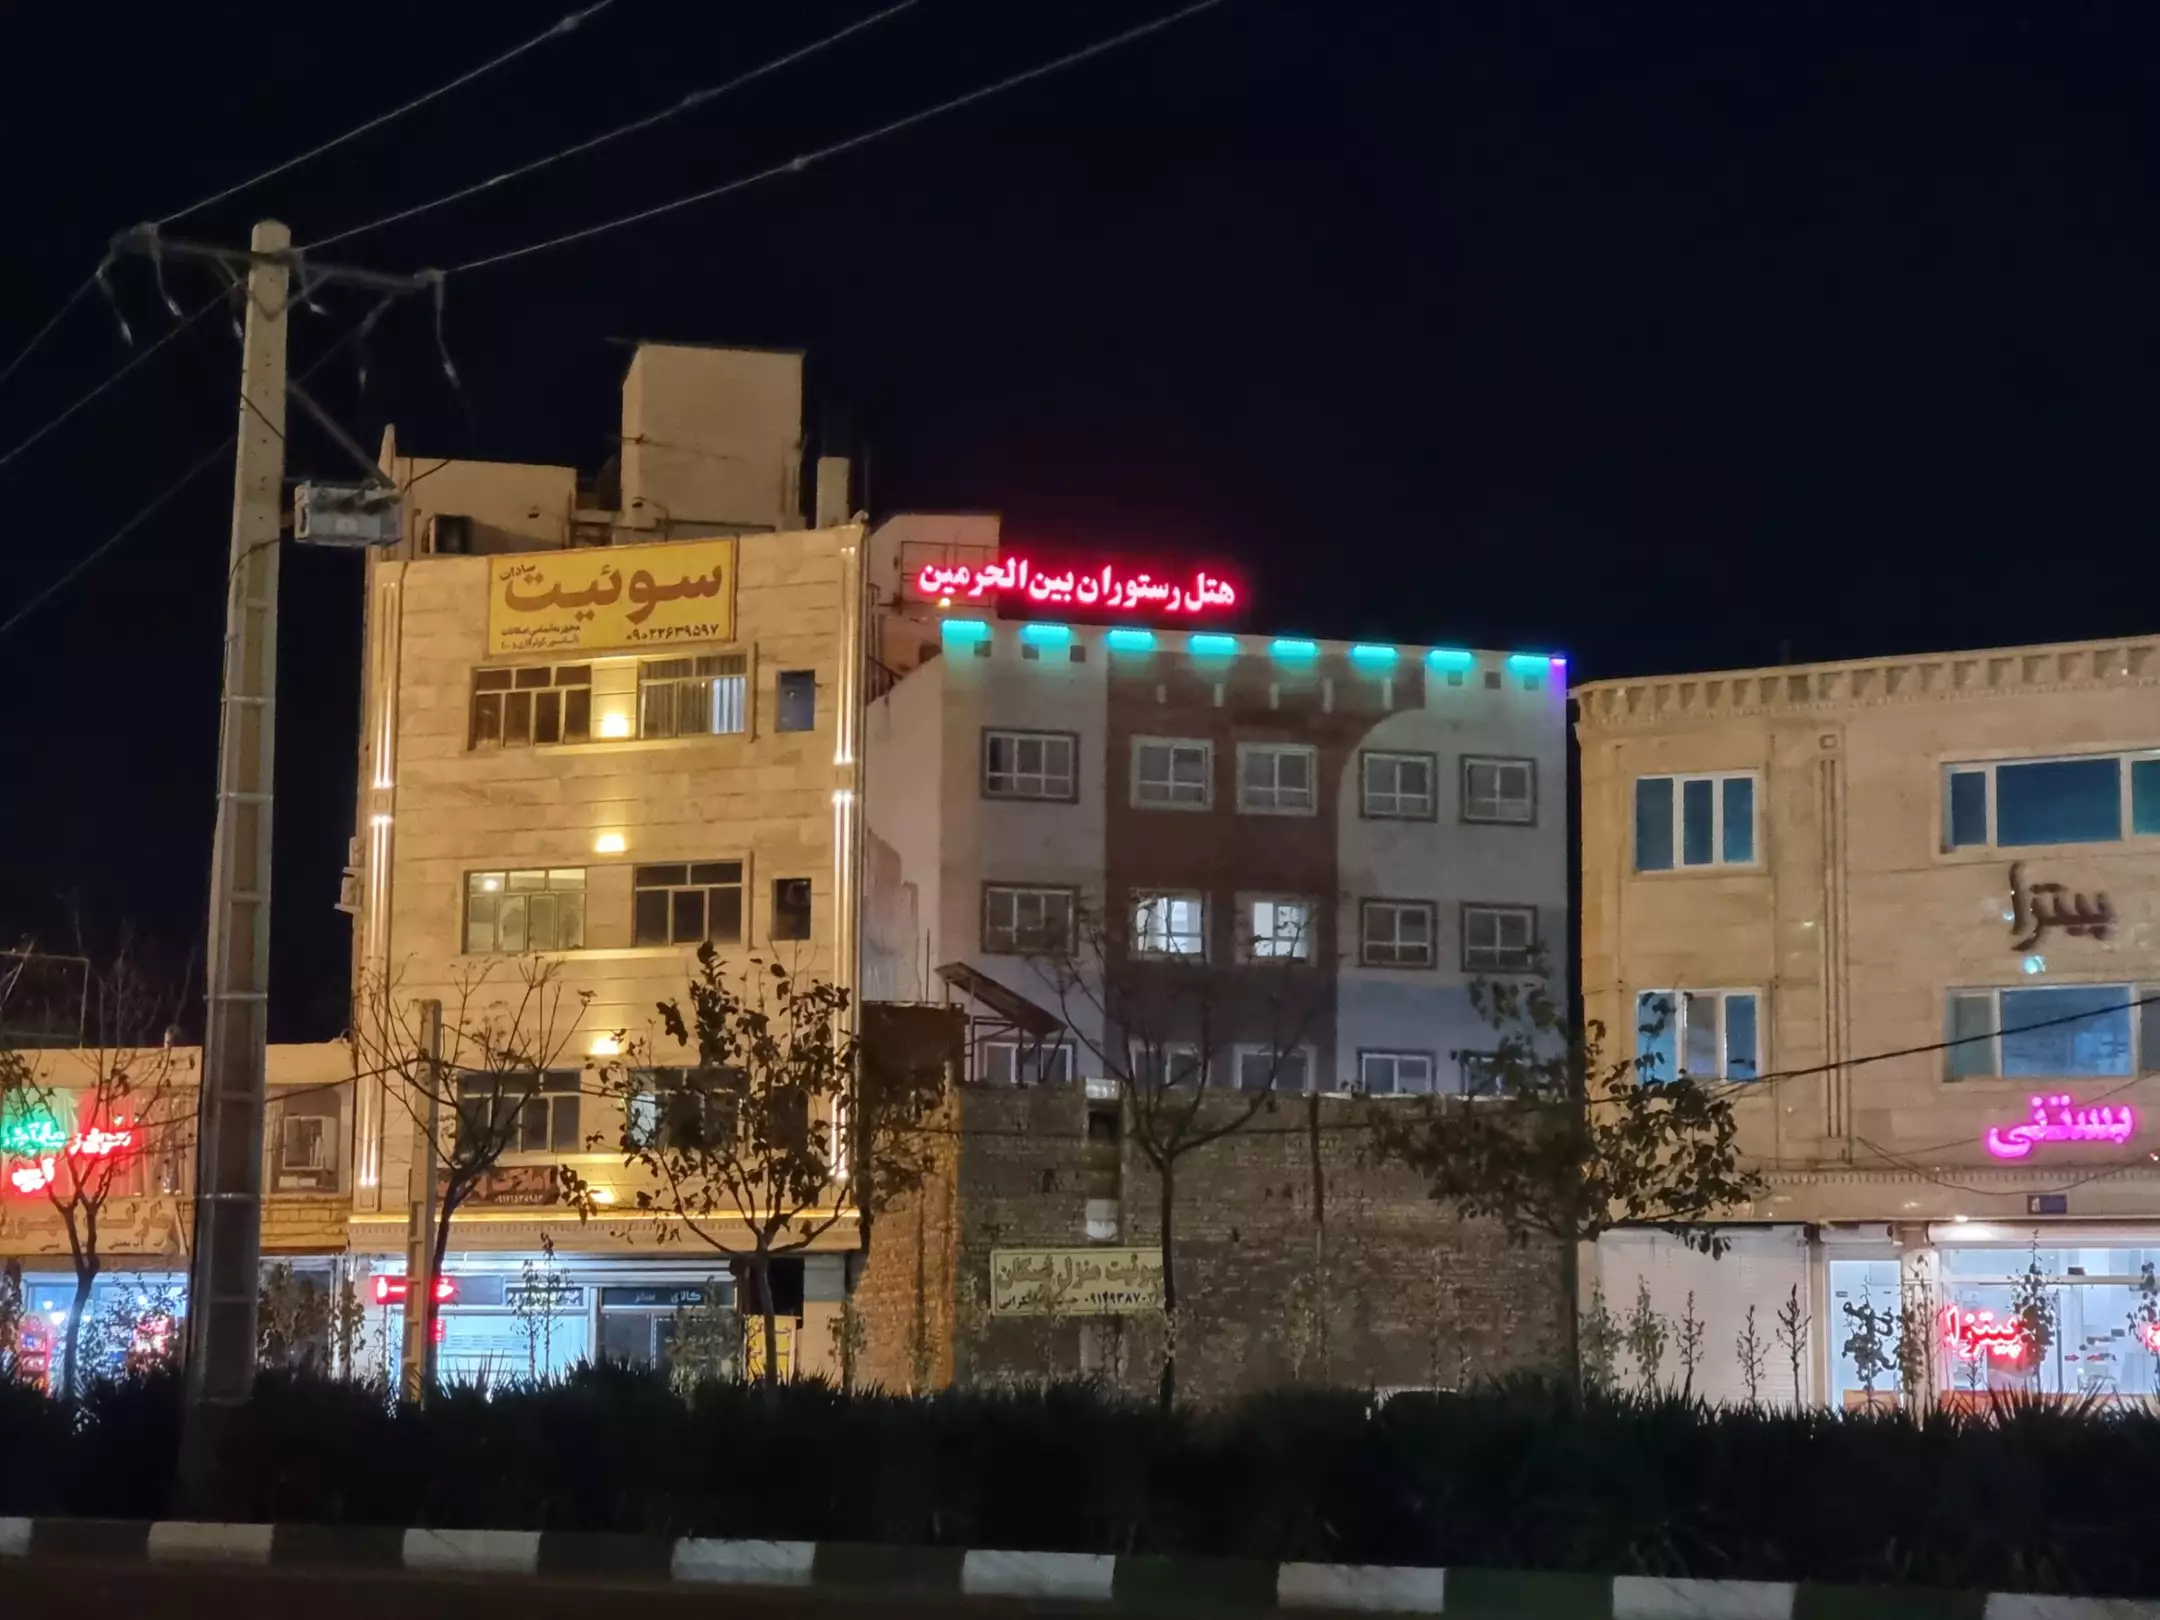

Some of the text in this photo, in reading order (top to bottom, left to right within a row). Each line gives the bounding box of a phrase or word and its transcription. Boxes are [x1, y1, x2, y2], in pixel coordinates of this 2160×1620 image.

[504, 563, 723, 625] سوئیت
[918, 556, 1236, 612] هتل رستوران بین الحرمین
[1987, 1093, 2133, 1158] بستنی
[1945, 1304, 2034, 1359] پیتزا
